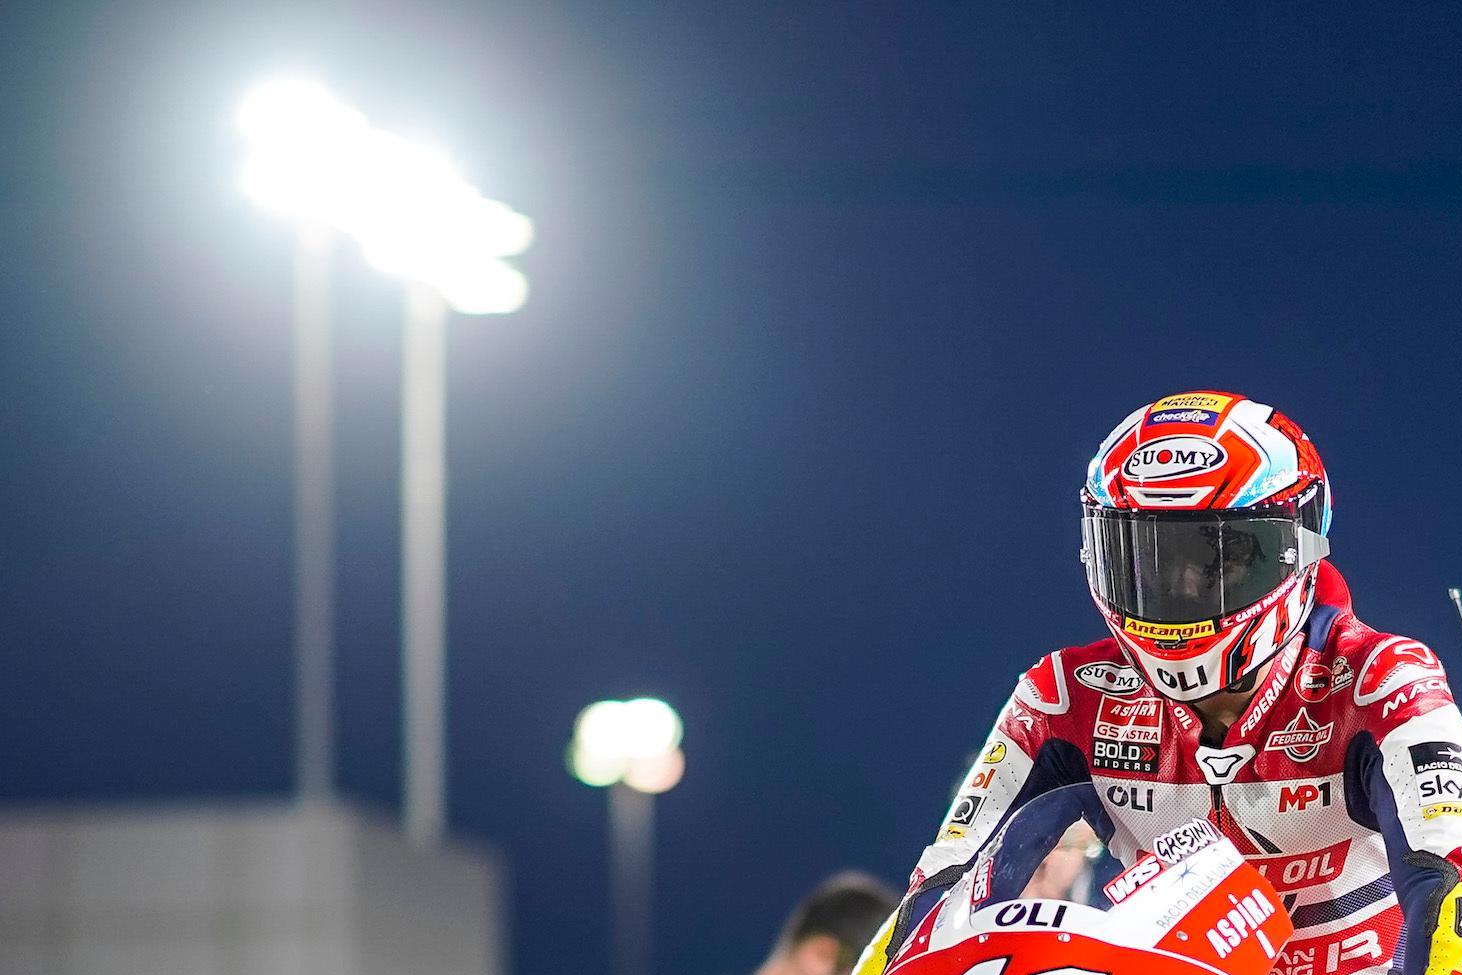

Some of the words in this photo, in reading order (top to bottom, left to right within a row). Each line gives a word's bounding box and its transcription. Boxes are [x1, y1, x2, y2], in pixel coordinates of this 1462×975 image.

[1131, 449, 1214, 468] SUOMY
[1125, 620, 1213, 637] Antangin
[1082, 666, 1144, 688] SUOMY
[1240, 672, 1289, 738] FEDERAL
[1174, 705, 1195, 730] OIL
[1097, 725, 1119, 738] GS
[1122, 729, 1159, 742] ASTRA
[1271, 731, 1315, 745] FEDERAL
[1315, 728, 1329, 741] OIL
[1094, 741, 1140, 761] BOLD
[1093, 759, 1151, 772] RIDERS
[1278, 782, 1331, 813] MP1
[1156, 819, 1218, 860] GRESINI
[1107, 855, 1162, 903] WAS
[1281, 851, 1337, 884] OIL
[1206, 888, 1276, 959] ASPIRA
